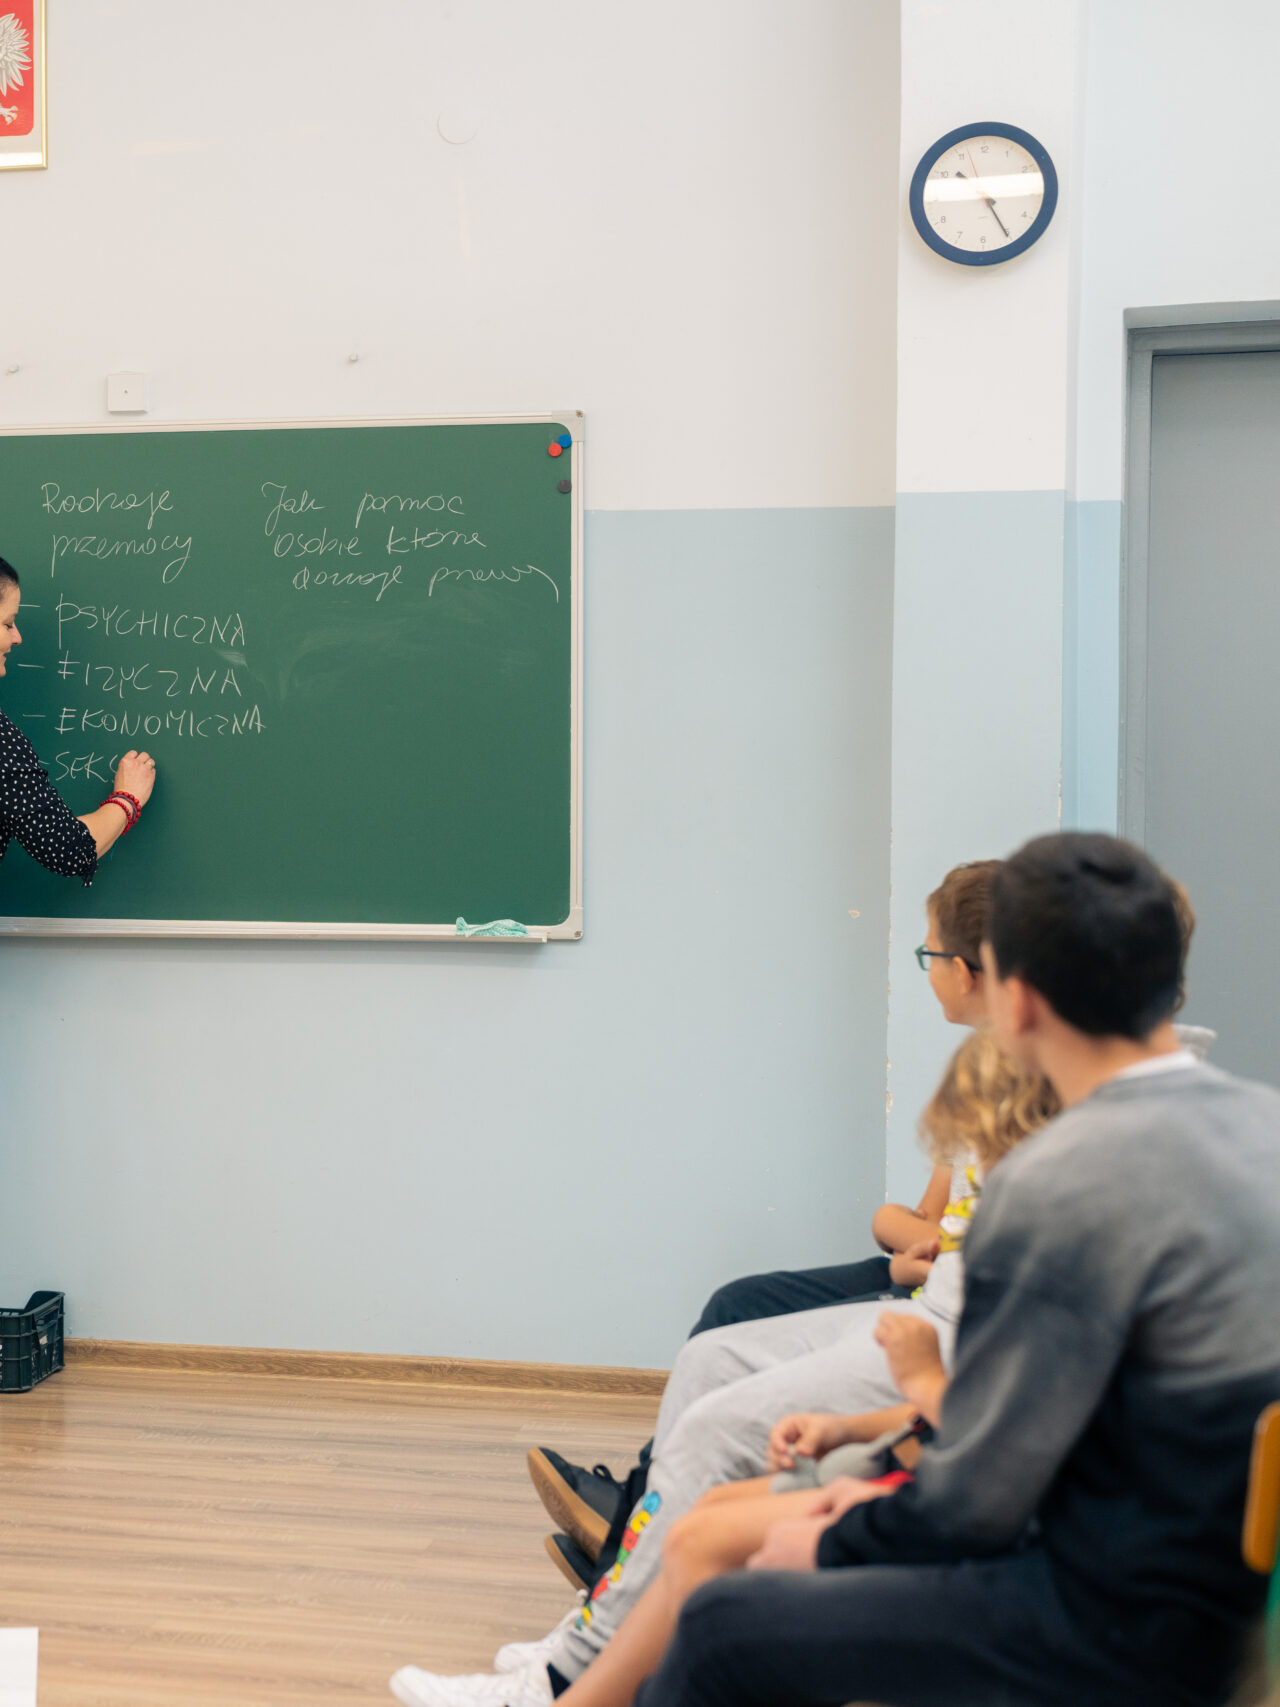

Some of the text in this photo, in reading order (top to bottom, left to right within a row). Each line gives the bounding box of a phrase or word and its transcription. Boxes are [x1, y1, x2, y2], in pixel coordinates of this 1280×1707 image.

[51, 534, 192, 585] przemocy
[55, 592, 246, 650] PSYCHICZNA
[57, 649, 242, 699] FIZYCZNA
[54, 704, 268, 738] EKONOMICZNA
